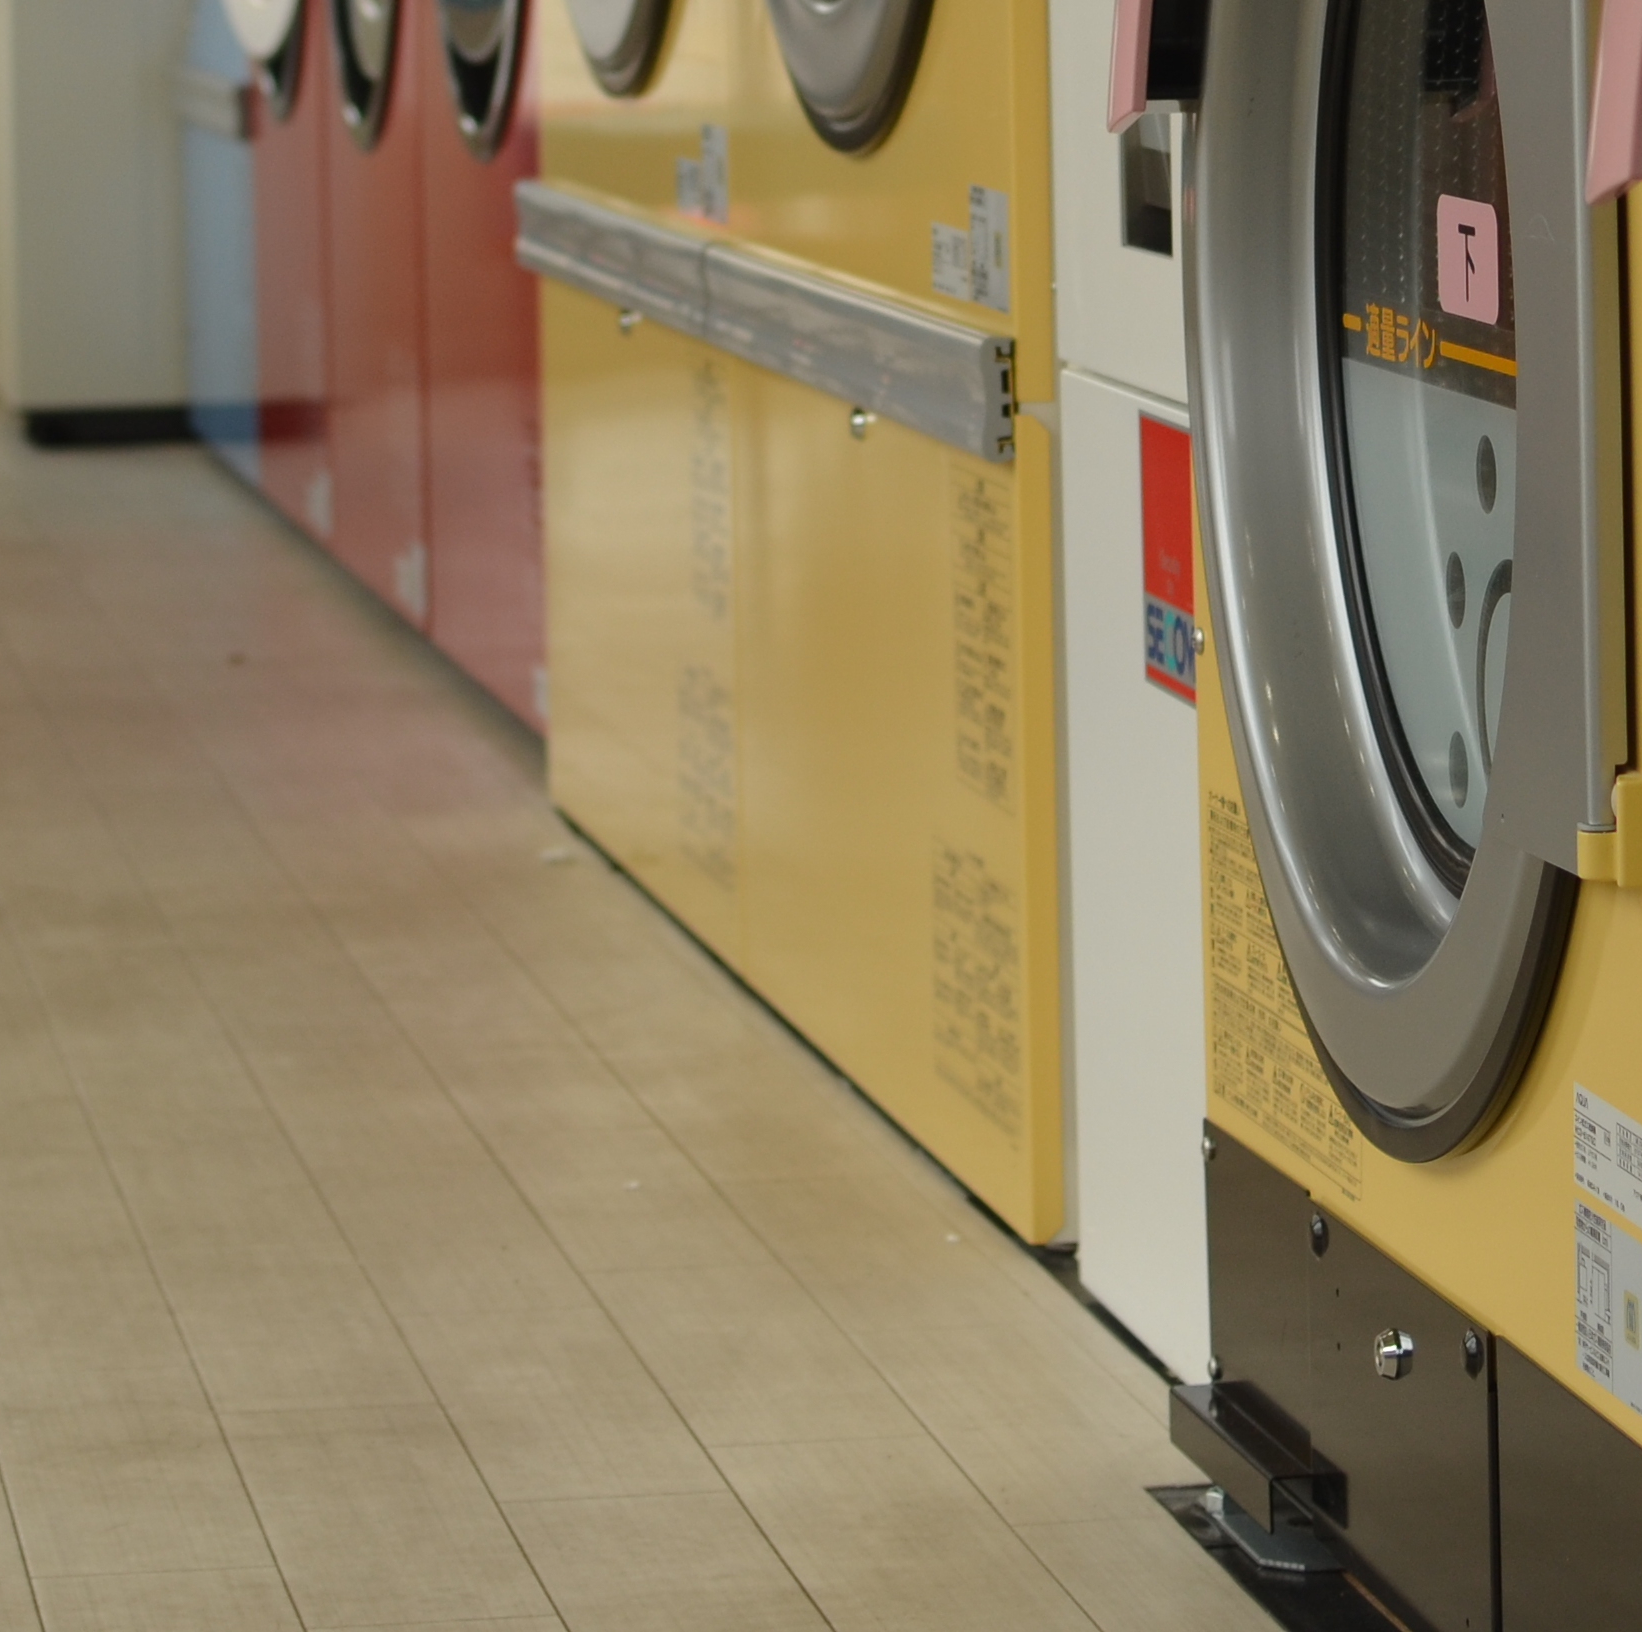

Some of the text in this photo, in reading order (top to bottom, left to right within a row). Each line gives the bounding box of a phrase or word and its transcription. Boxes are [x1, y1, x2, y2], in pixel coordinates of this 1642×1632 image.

[1458, 223, 1476, 302] 下
[1366, 302, 1436, 369] 適量ライン
